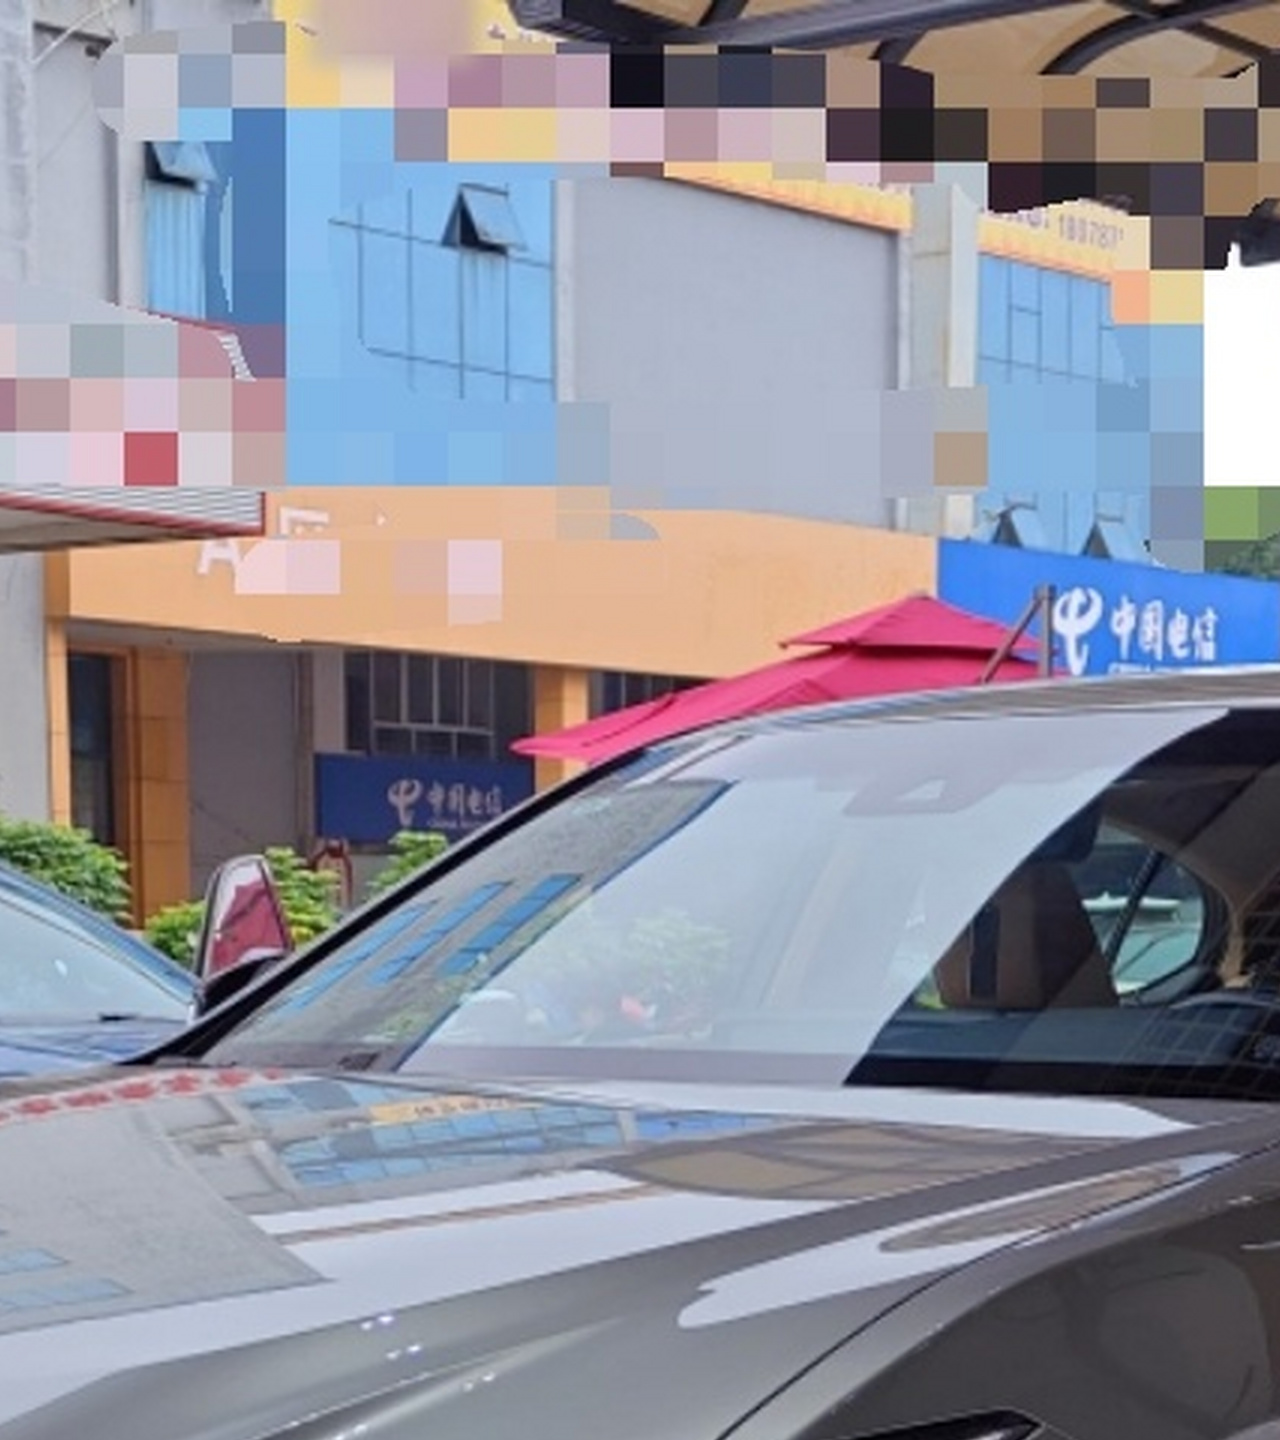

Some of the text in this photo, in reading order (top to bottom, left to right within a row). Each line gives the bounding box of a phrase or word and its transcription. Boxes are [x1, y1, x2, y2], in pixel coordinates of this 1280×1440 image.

[1110, 594, 1217, 662] 中国电信
[426, 780, 502, 818] 中国电信
